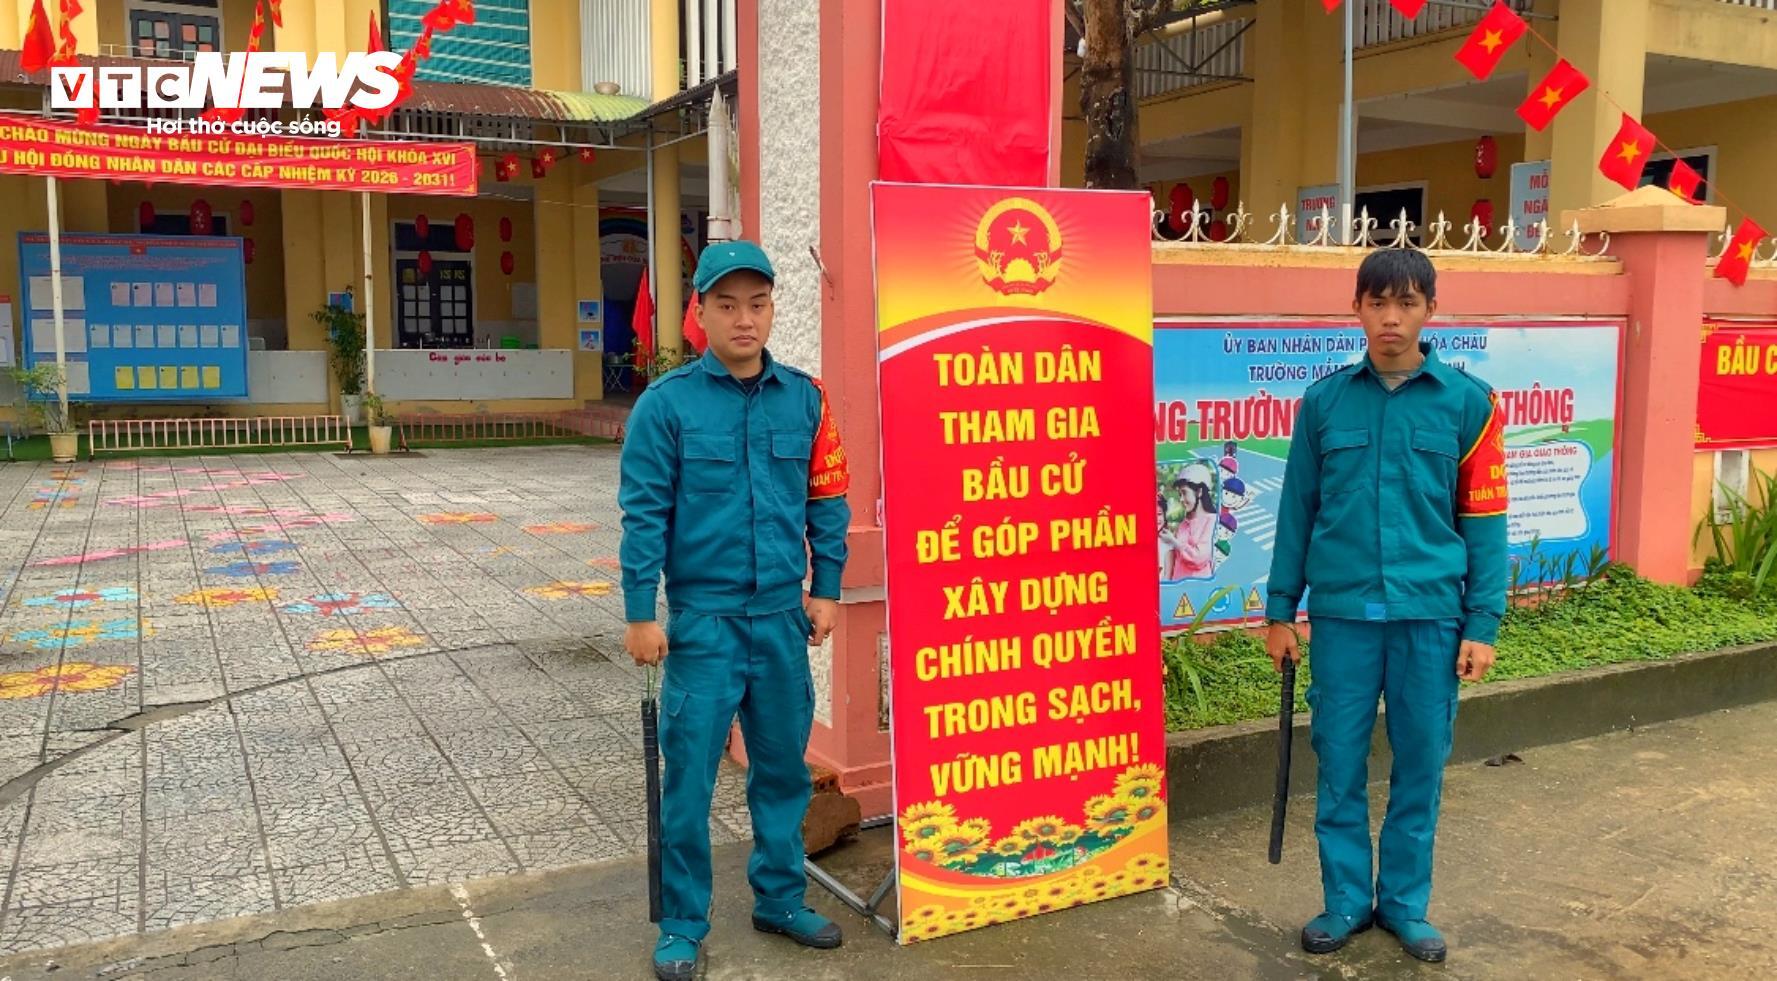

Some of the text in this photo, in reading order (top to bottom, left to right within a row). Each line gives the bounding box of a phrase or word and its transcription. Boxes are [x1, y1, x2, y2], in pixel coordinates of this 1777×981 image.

[13, 147, 45, 168] HỘI
[50, 149, 100, 170] ĐỒNG
[107, 156, 156, 173] NHÂN
[161, 158, 196, 175] DÂN
[202, 161, 236, 176] CÁC
[241, 161, 274, 178] CẤP
[279, 164, 331, 184] NHIỆM
[361, 169, 399, 184] 2026
[413, 171, 455, 186] 2031!
[54, 126, 110, 147] MỪNG
[115, 134, 162, 150] NGÀY
[168, 134, 202, 152] BẦU
[208, 137, 231, 154] CỬ
[235, 141, 263, 158] ĐẠI
[268, 140, 304, 158] BIỂU
[309, 143, 351, 160] QUỐC
[389, 149, 427, 166] KHÓA
[432, 152, 456, 165] XVI
[1223, 332, 1242, 354] ỦY
[1247, 338, 1277, 354] BAN
[1281, 333, 1323, 353] NHÂN
[1327, 331, 1355, 353] DÂN
[1451, 332, 1487, 350] CHÂU
[1717, 335, 1777, 376] BẦU C
[933, 344, 1101, 387] TOÀN DÂN
[1249, 362, 1307, 382] TRƯỜNG
[939, 406, 1100, 445] THAM GIA
[1502, 382, 1574, 426] THÔNG
[962, 451, 1087, 502] BẦU CỬ
[916, 505, 1137, 564] ĐỂ GÓP PHẦN
[943, 571, 1108, 620] XÂY DỰNG
[915, 615, 1136, 681] CHÍNH QUYỀN
[923, 678, 1142, 739] TRONG SẠCH,
[929, 732, 1140, 797] VỮNG MẠNH!
